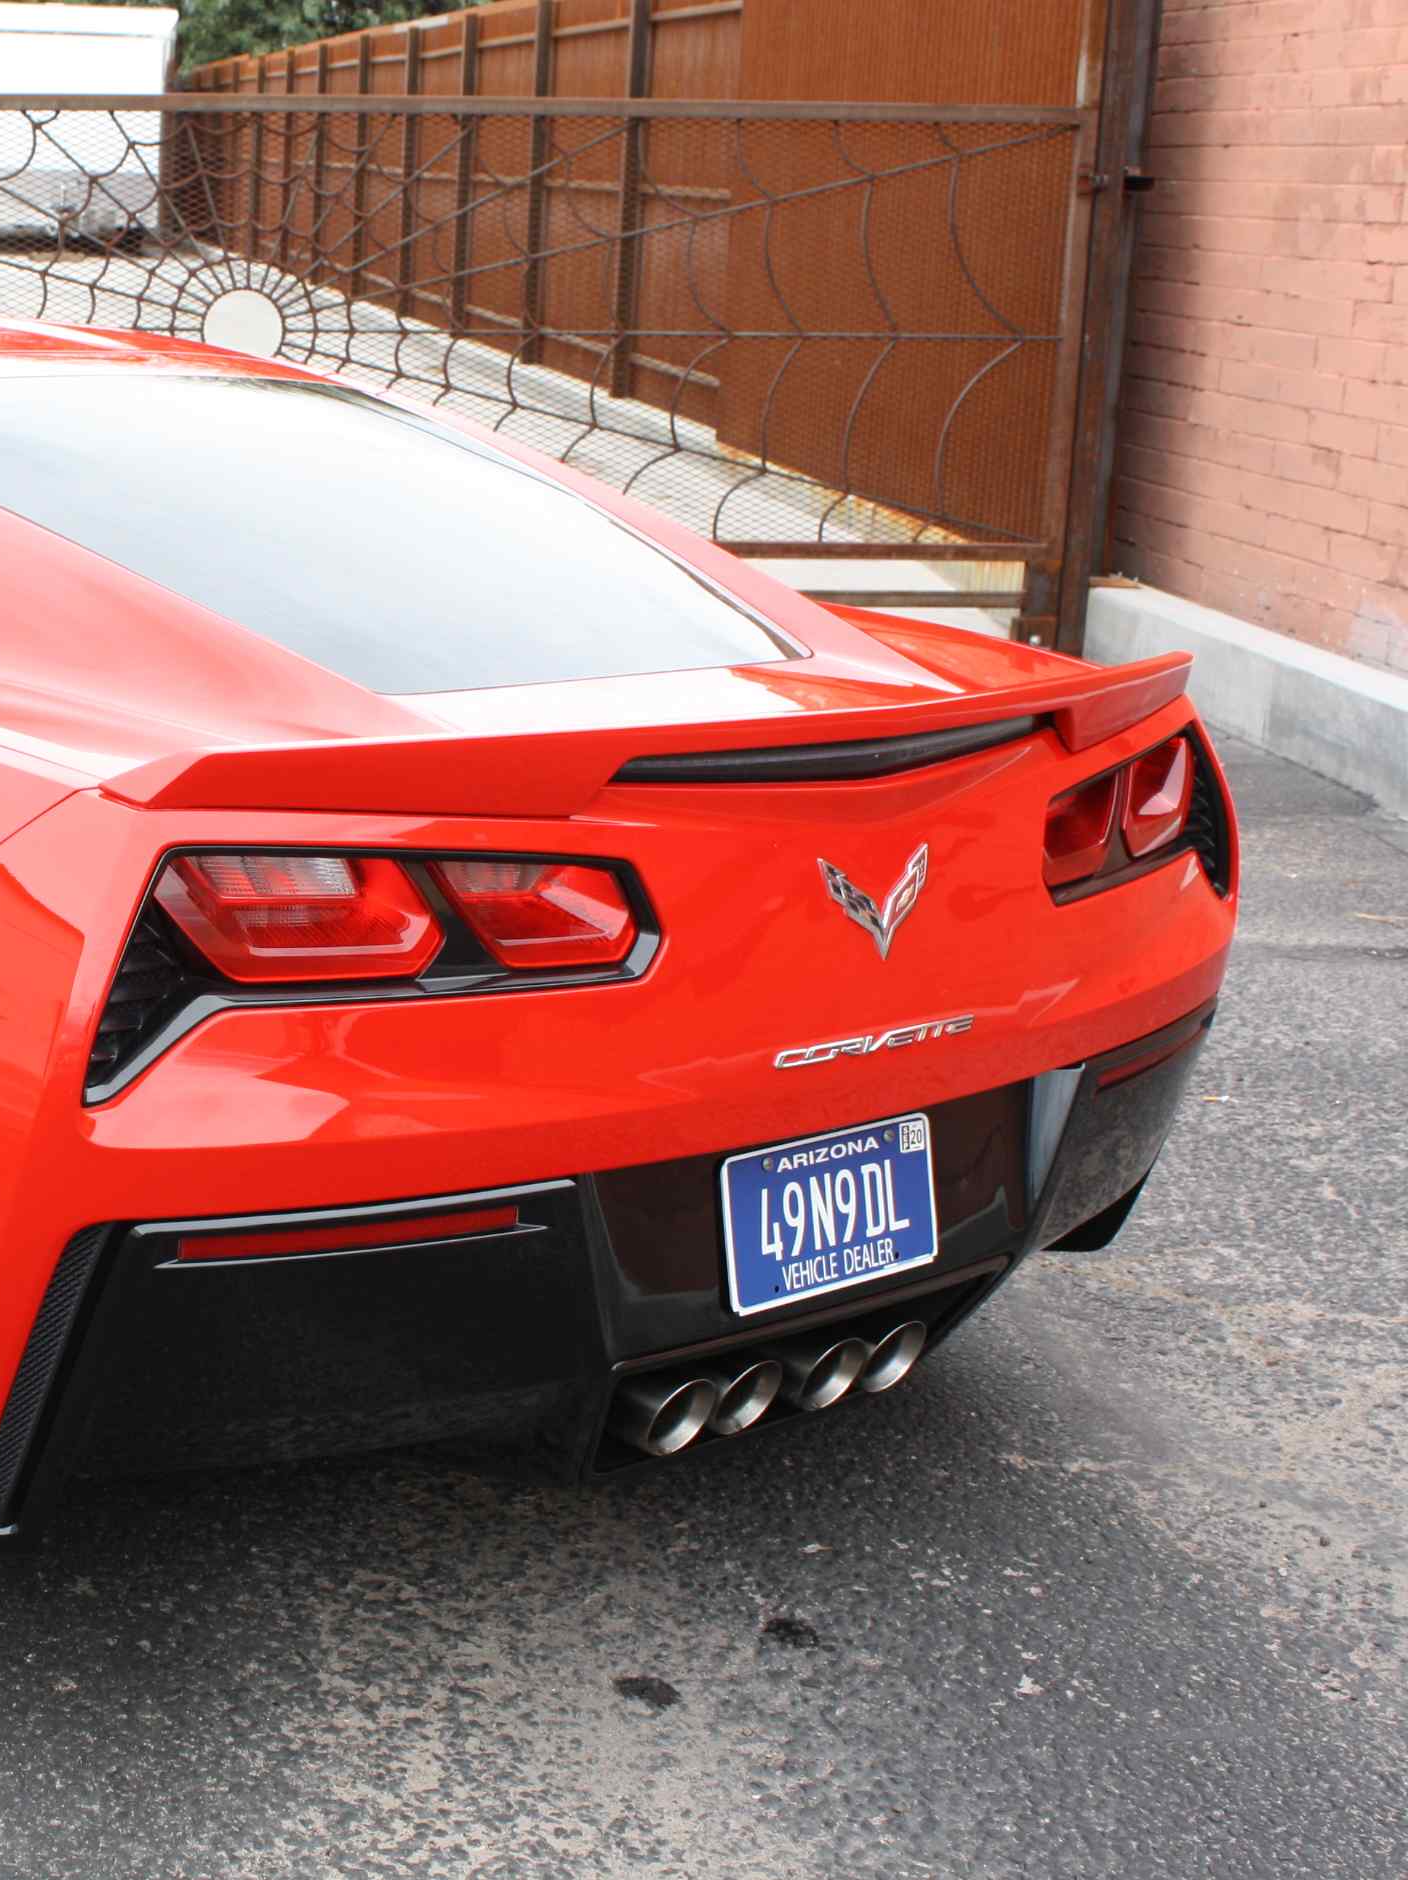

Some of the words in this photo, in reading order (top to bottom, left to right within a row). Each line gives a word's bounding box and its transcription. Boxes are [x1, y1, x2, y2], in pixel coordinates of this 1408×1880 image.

[774, 1013, 975, 1068] CORVETTE
[776, 1136, 879, 1173] ARIZONA
[911, 1129, 923, 1145] 20
[761, 1159, 911, 1261] 49N9DL
[782, 1252, 839, 1291] VEHICLE
[843, 1238, 894, 1275] DEALER
